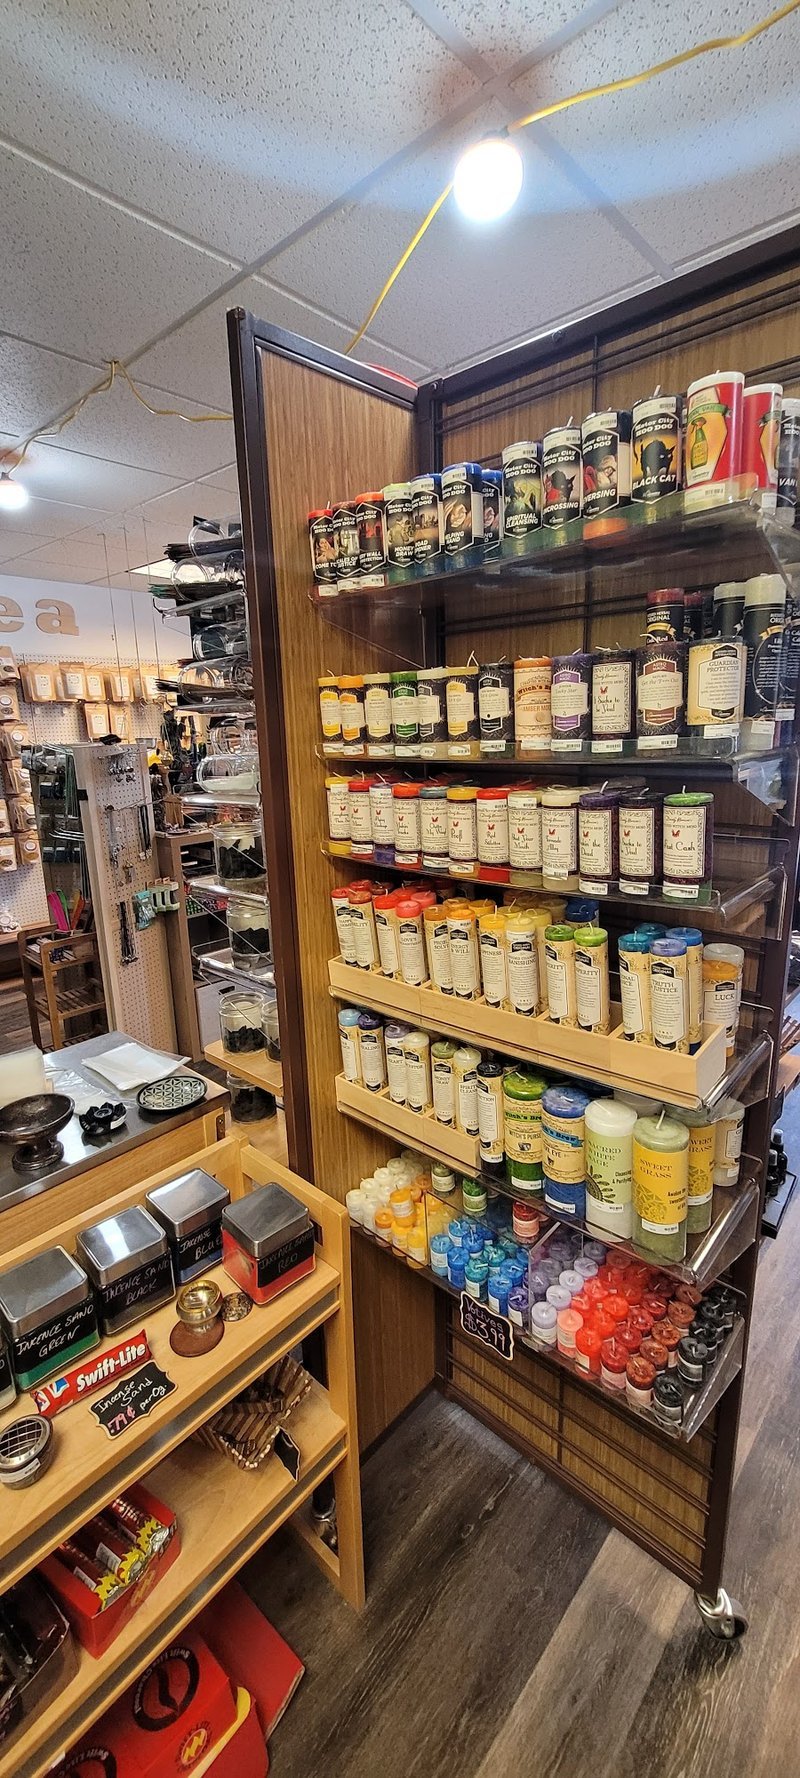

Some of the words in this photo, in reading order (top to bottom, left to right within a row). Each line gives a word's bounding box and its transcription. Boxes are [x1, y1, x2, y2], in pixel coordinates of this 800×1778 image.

[635, 420, 656, 431] Motor
[654, 423, 673, 431] DOO
[596, 434, 612, 442] City
[594, 440, 611, 448] DOO
[505, 465, 522, 474] Motor
[520, 468, 536, 476] DOO
[632, 475, 658, 490] BLACK
[659, 474, 676, 483] CAT
[583, 488, 616, 504] VERSING
[543, 502, 578, 514] CROSSING
[506, 513, 536, 522] SPIRITUAL
[506, 518, 538, 528] CLEANSING
[336, 556, 350, 564] CALES
[315, 562, 330, 570] COME
[518, 684, 543, 694] Witch's
[676, 841, 696, 851] Cash
[556, 1132, 576, 1142] Brew
[552, 1150, 561, 1158] EYE
[640, 1158, 672, 1170] SWEET
[640, 1166, 672, 1178] GRASS
[144, 1259, 170, 1279] SAND
[126, 1278, 157, 1306] BLACK
[65, 1304, 94, 1327] SAND
[464, 1296, 504, 1333] Votives
[464, 1313, 505, 1351] $3.99
[38, 1324, 80, 1357] GREEN
[77, 1344, 146, 1392] Swift-Lite
[94, 1381, 136, 1414] Incense
[121, 1378, 154, 1407] Sand
